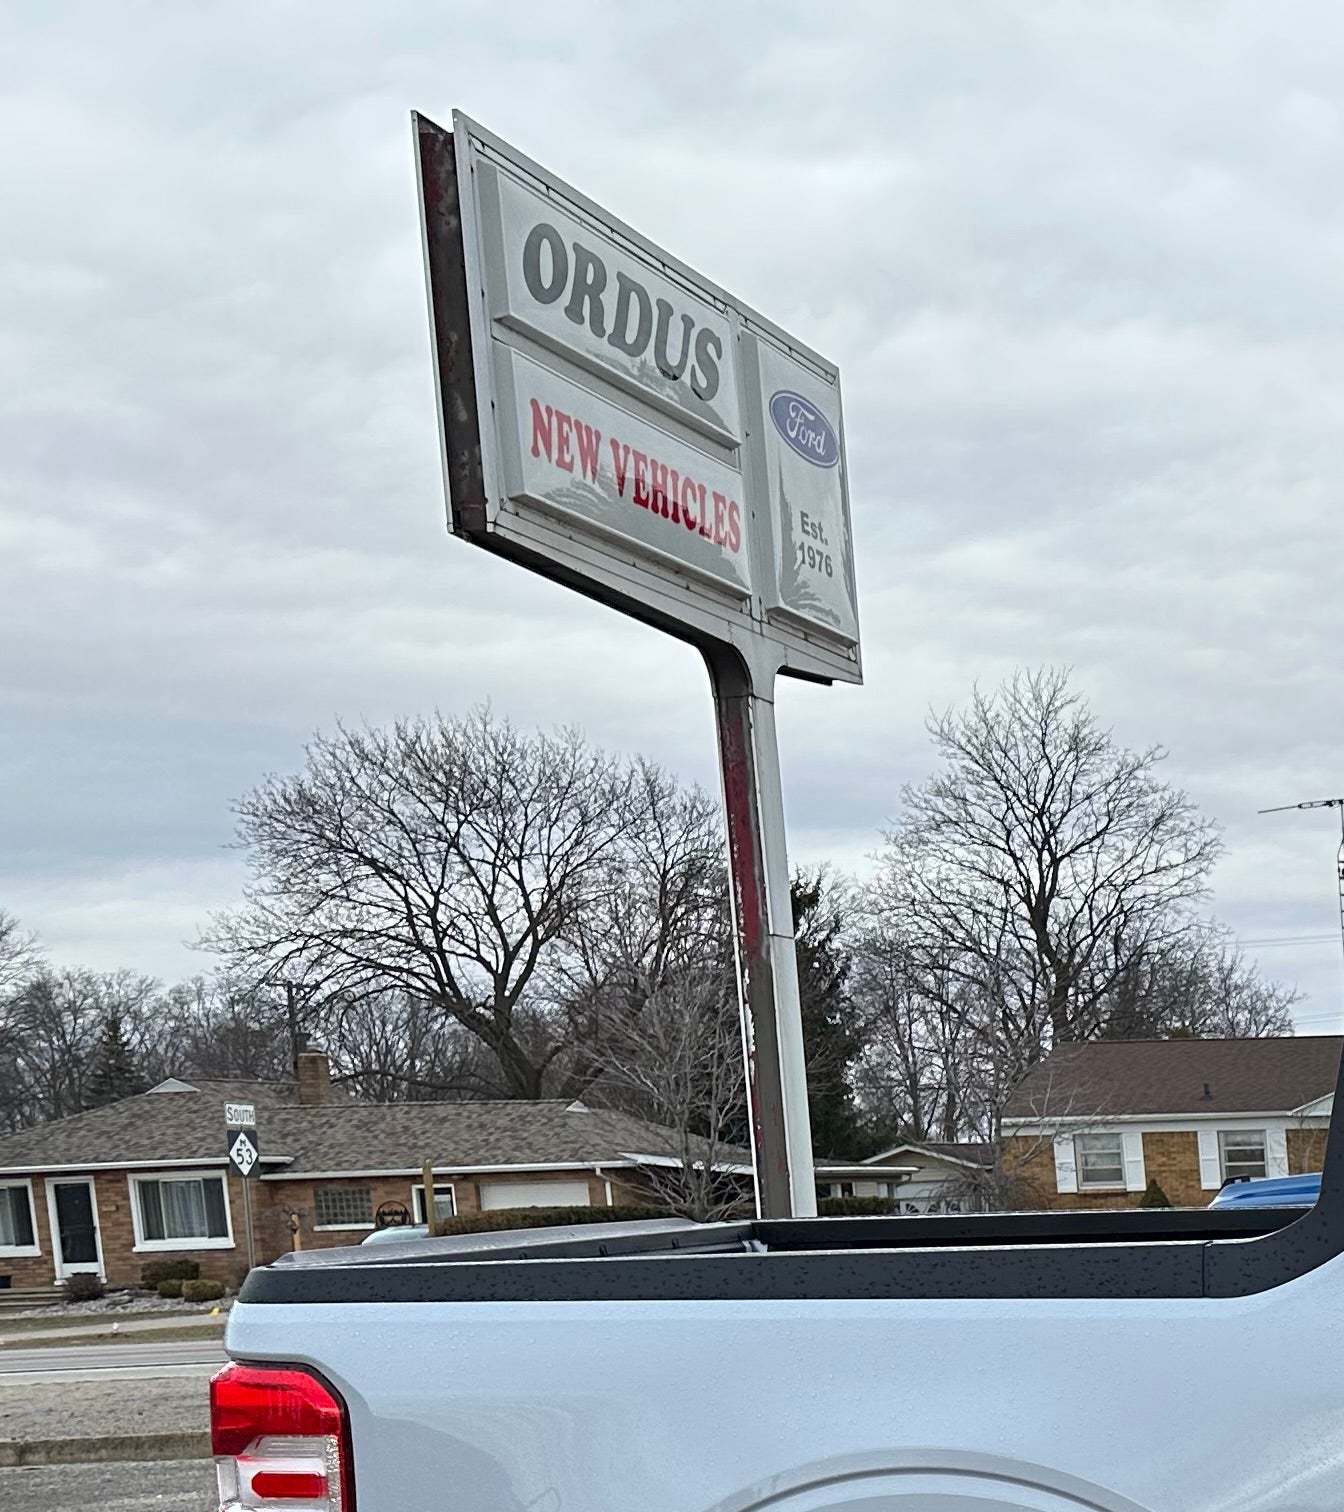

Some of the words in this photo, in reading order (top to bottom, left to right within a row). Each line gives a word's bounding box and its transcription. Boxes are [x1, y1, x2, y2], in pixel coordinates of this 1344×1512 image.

[523, 223, 722, 402] ORDUS
[787, 401, 827, 456] Ford
[530, 398, 601, 484] NEW
[610, 438, 740, 553] VEHICLES
[800, 511, 829, 546] Est.
[799, 542, 833, 578] 1976
[227, 1106, 255, 1122] SOUTH
[236, 1148, 253, 1165] 53
[239, 1138, 247, 1147] M
